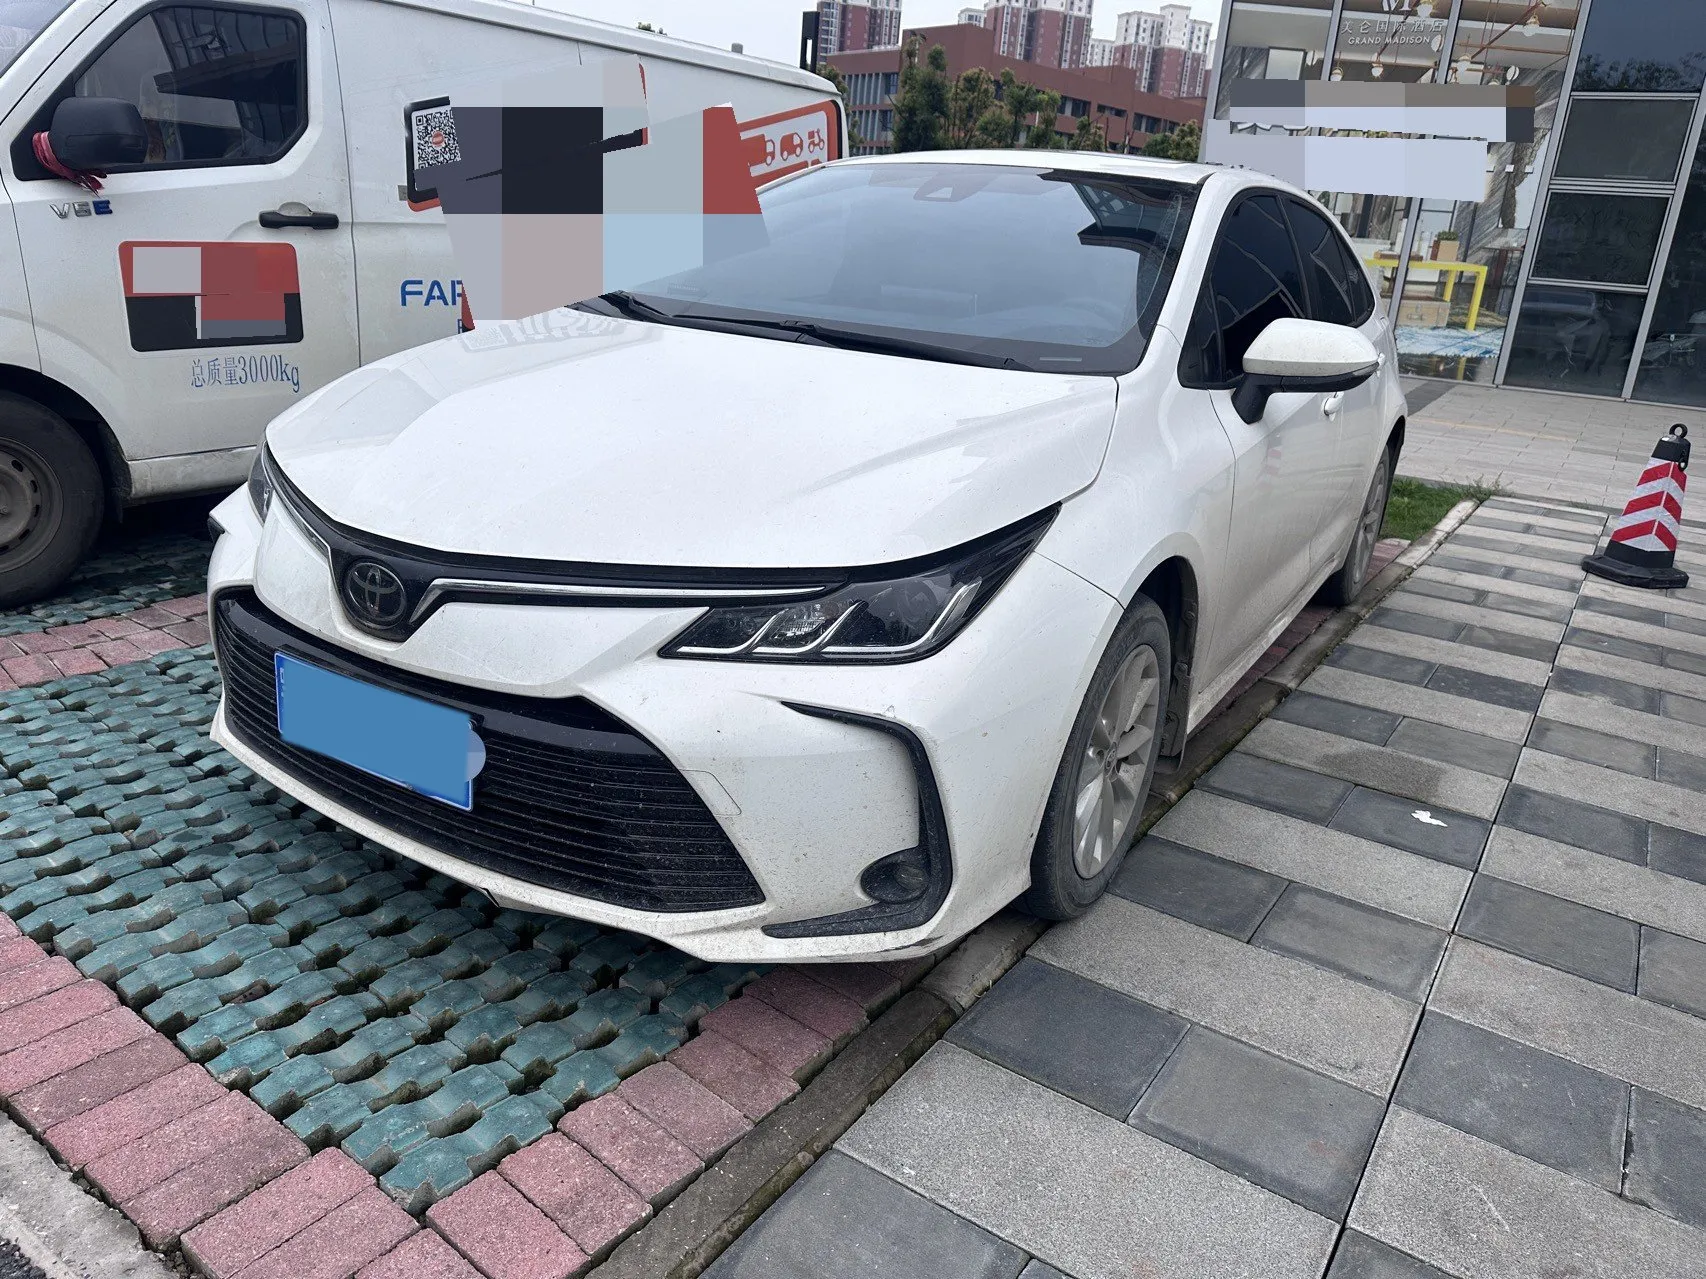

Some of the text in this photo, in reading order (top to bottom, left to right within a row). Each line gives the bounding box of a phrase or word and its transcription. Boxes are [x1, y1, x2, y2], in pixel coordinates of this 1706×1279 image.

[1348, 35, 1430, 45] GRAND MADISON
[191, 354, 300, 393] 总质量3000kg
